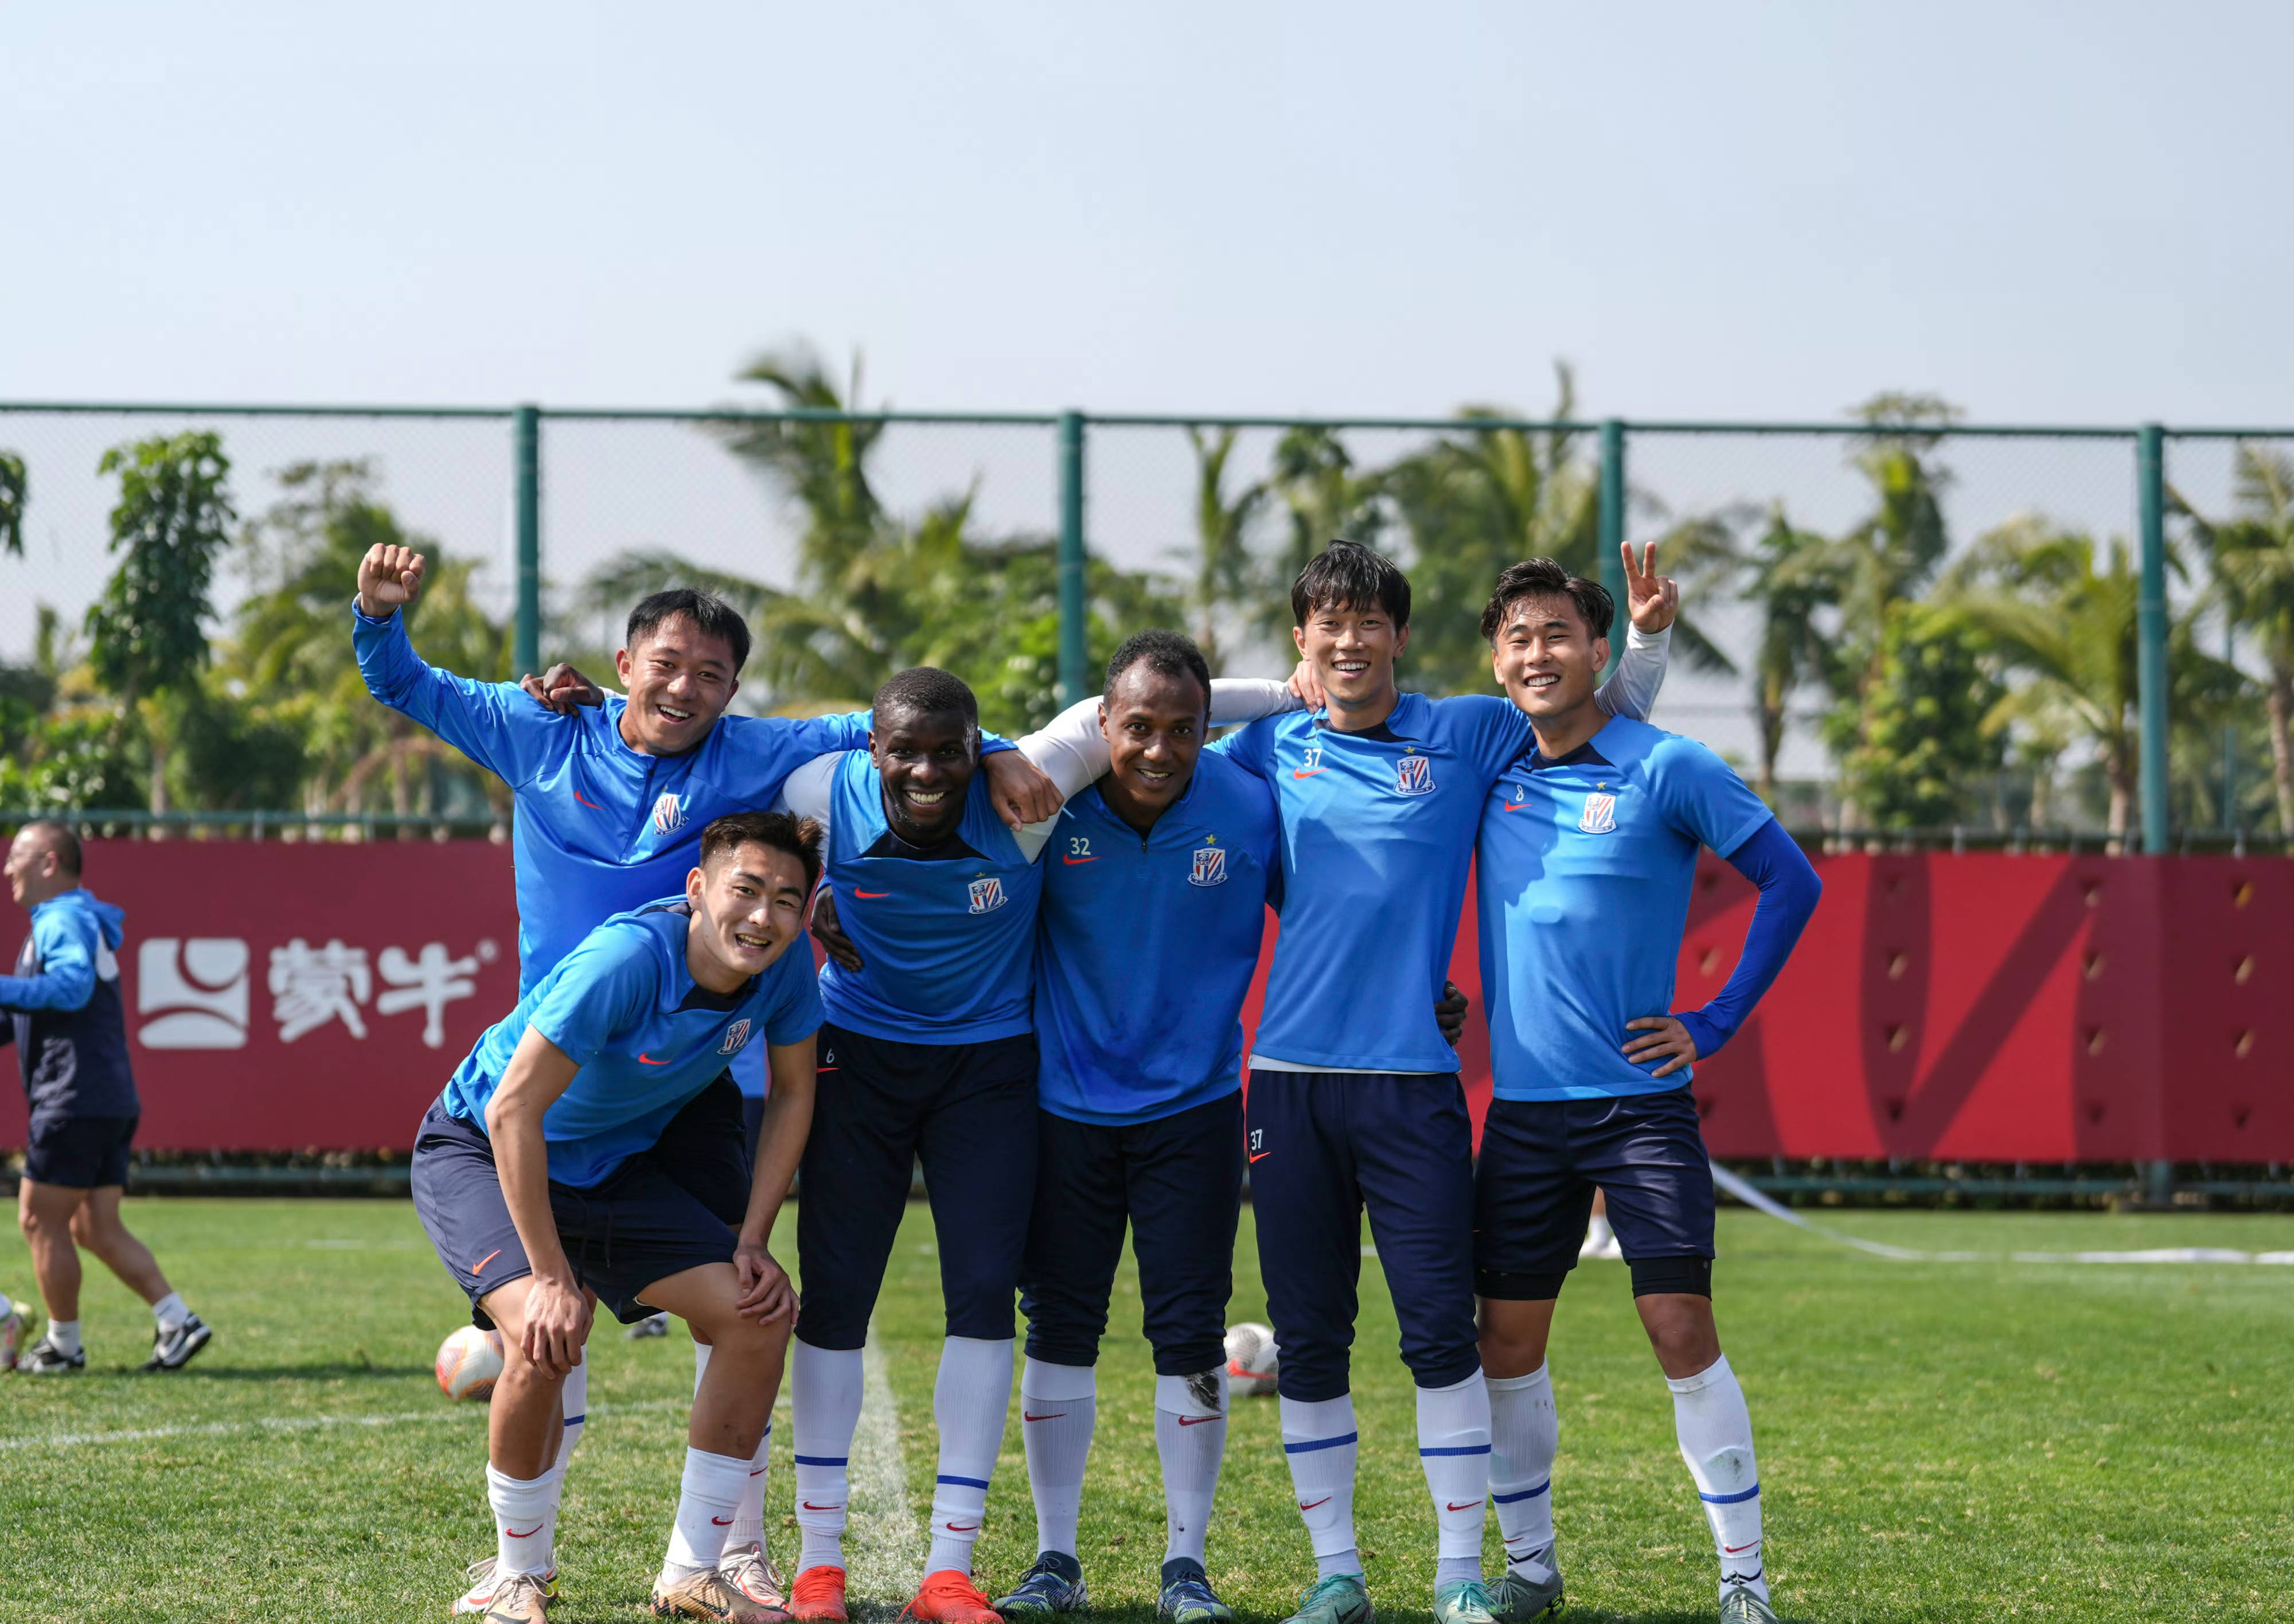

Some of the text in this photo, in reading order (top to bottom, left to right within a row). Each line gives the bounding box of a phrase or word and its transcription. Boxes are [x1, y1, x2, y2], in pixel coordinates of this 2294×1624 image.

[1304, 748, 1322, 767] 37
[1515, 784, 1524, 802] 8
[1070, 837, 1091, 855] 32
[268, 938, 479, 1048] 蒙牛
[826, 1048, 835, 1064] 6
[1250, 1129, 1263, 1151] 37
